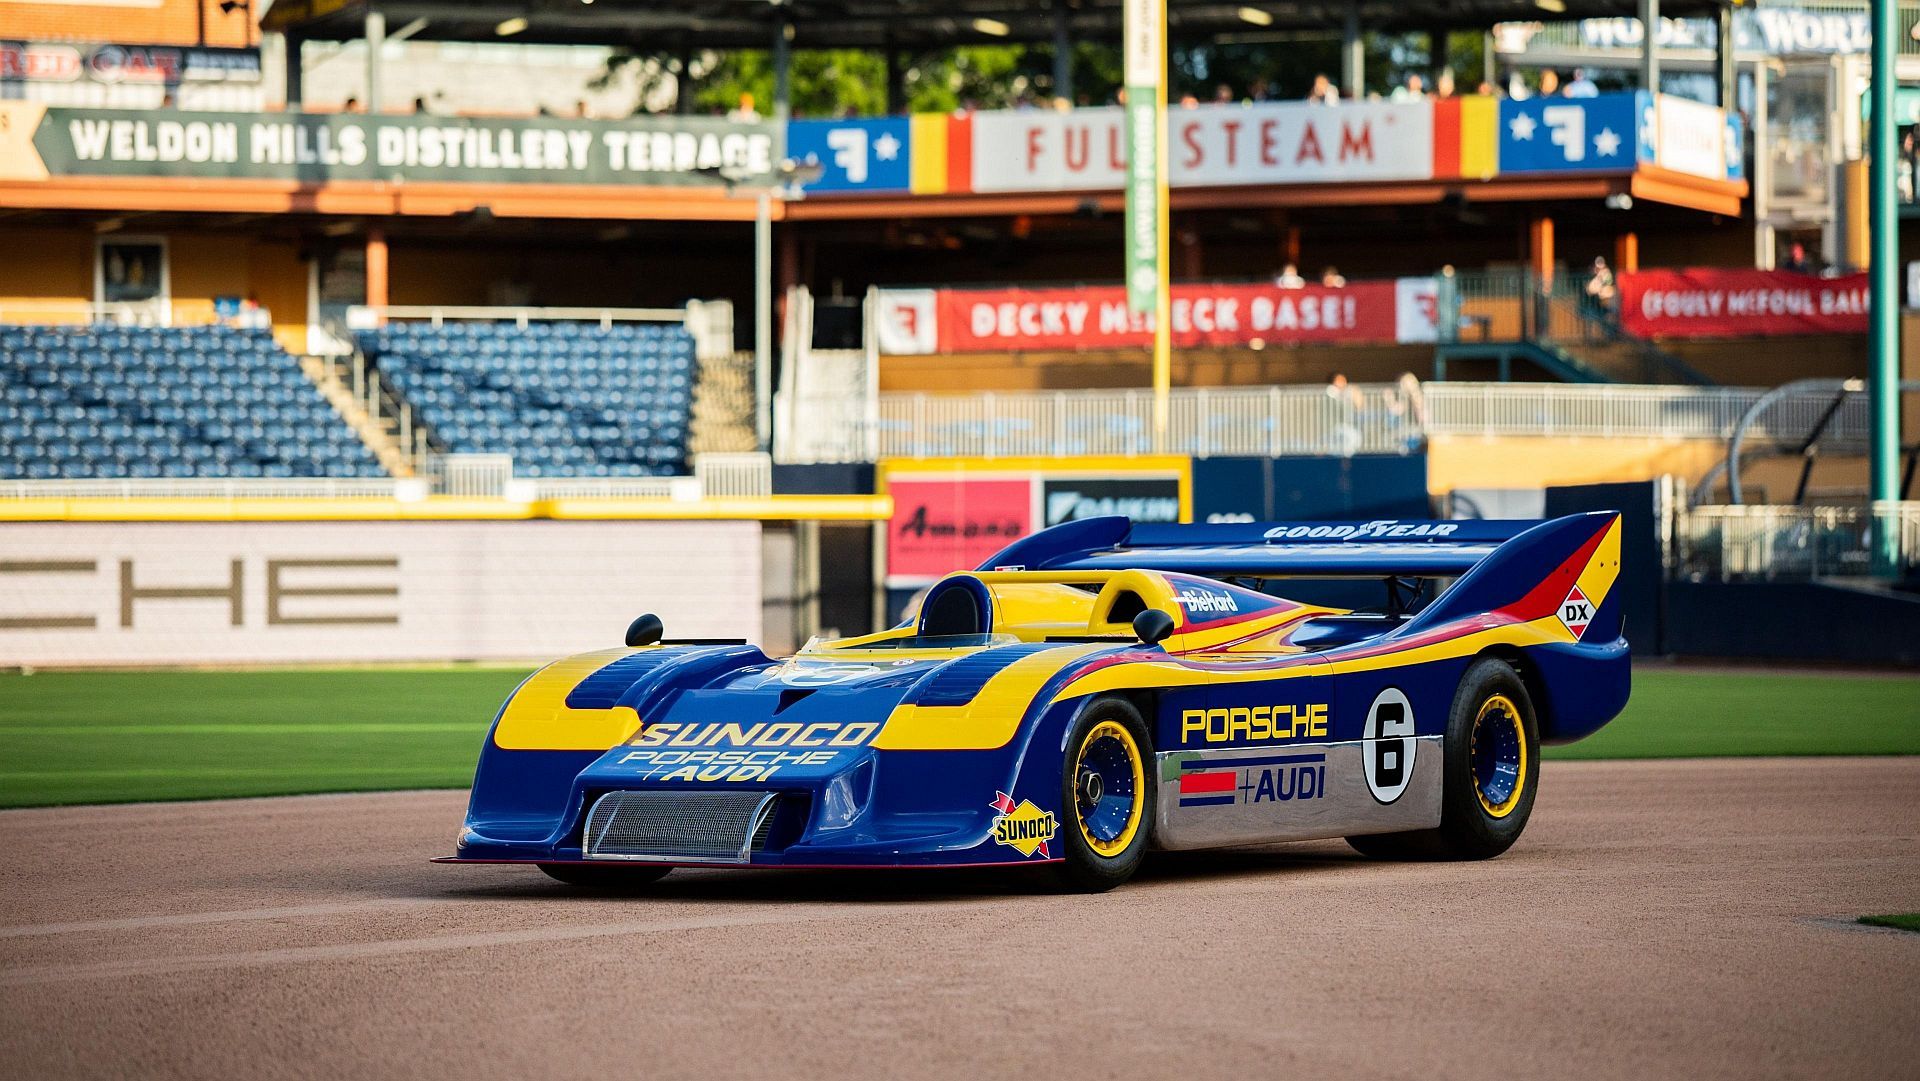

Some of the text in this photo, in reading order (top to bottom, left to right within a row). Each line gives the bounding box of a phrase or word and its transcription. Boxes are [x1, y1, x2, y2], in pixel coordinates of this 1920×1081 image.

[1755, 9, 1873, 53] WORL
[69, 119, 772, 175] WELDON MILLS DISTILLERY TERRACE
[970, 302, 1088, 337] DECKY
[1250, 295, 1357, 331] BASE!
[1263, 519, 1459, 541] GOODYEAR
[1181, 590, 1239, 612] DieHard
[1565, 604, 1589, 622] DX
[630, 722, 880, 747] SUNOCO
[1181, 703, 1329, 744] PORSCHE
[616, 751, 839, 765] PORSCHE
[1374, 702, 1405, 788] 6
[996, 814, 1052, 842] SUNOCO
